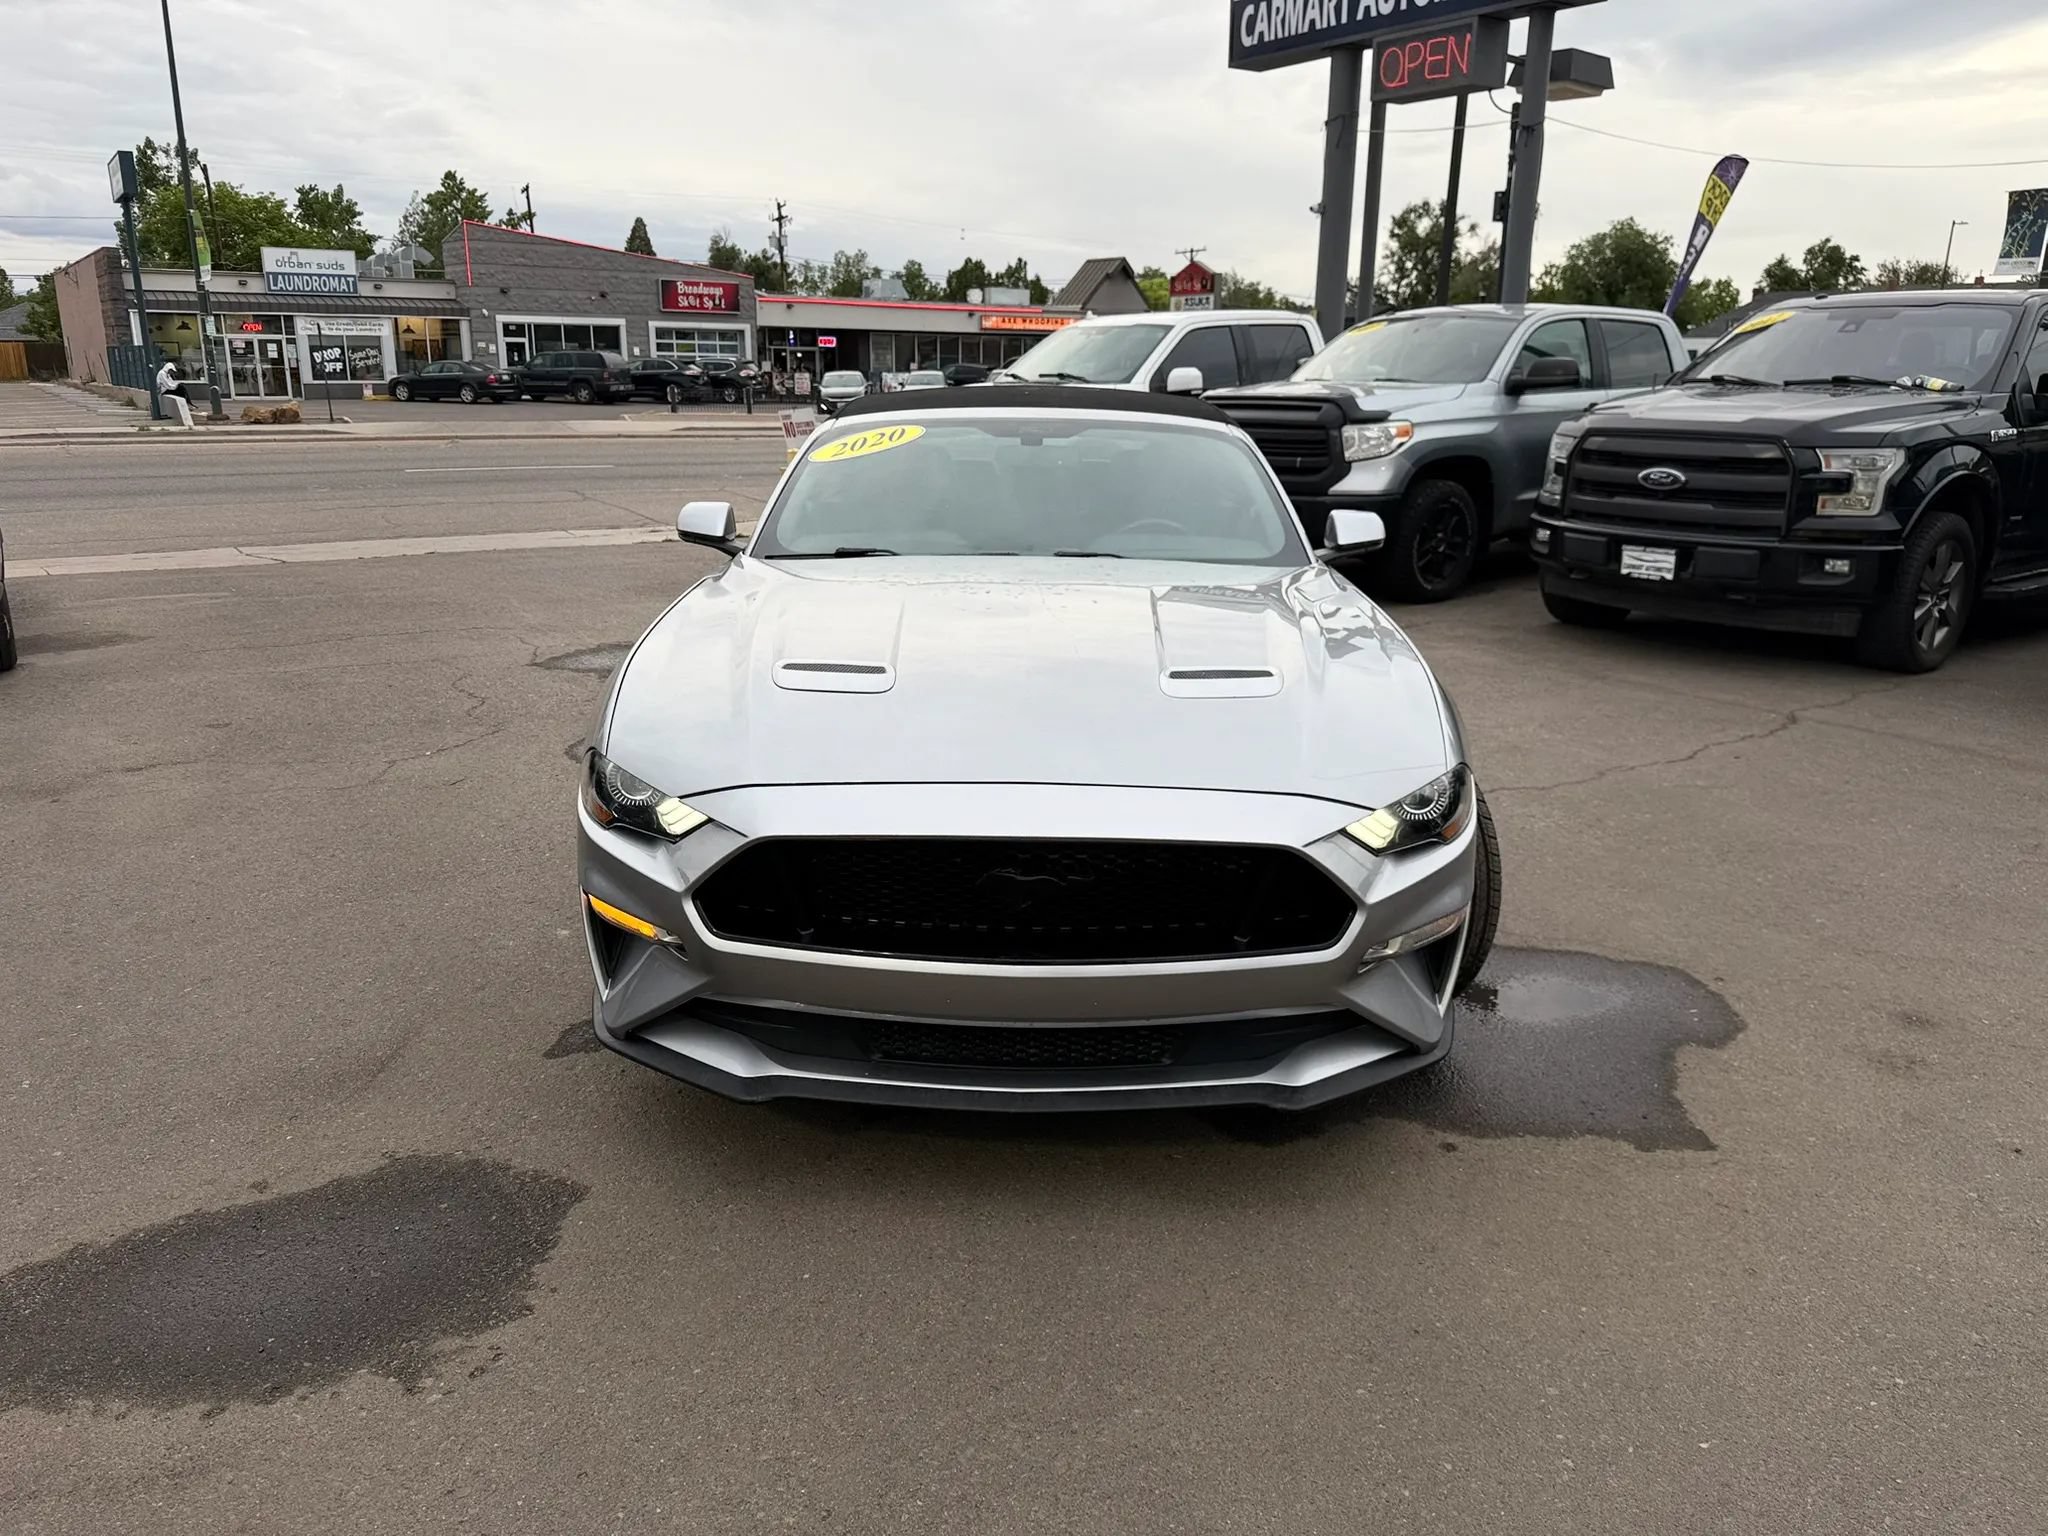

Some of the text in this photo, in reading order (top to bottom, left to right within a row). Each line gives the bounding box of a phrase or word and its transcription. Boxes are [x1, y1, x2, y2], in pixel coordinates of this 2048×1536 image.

[1380, 33, 1471, 87] OPEN
[316, 261, 345, 270] suds
[269, 274, 355, 292] LAUNDROMAT
[242, 323, 263, 331] OPEN
[783, 421, 796, 439] NO
[831, 427, 906, 458] 2020
